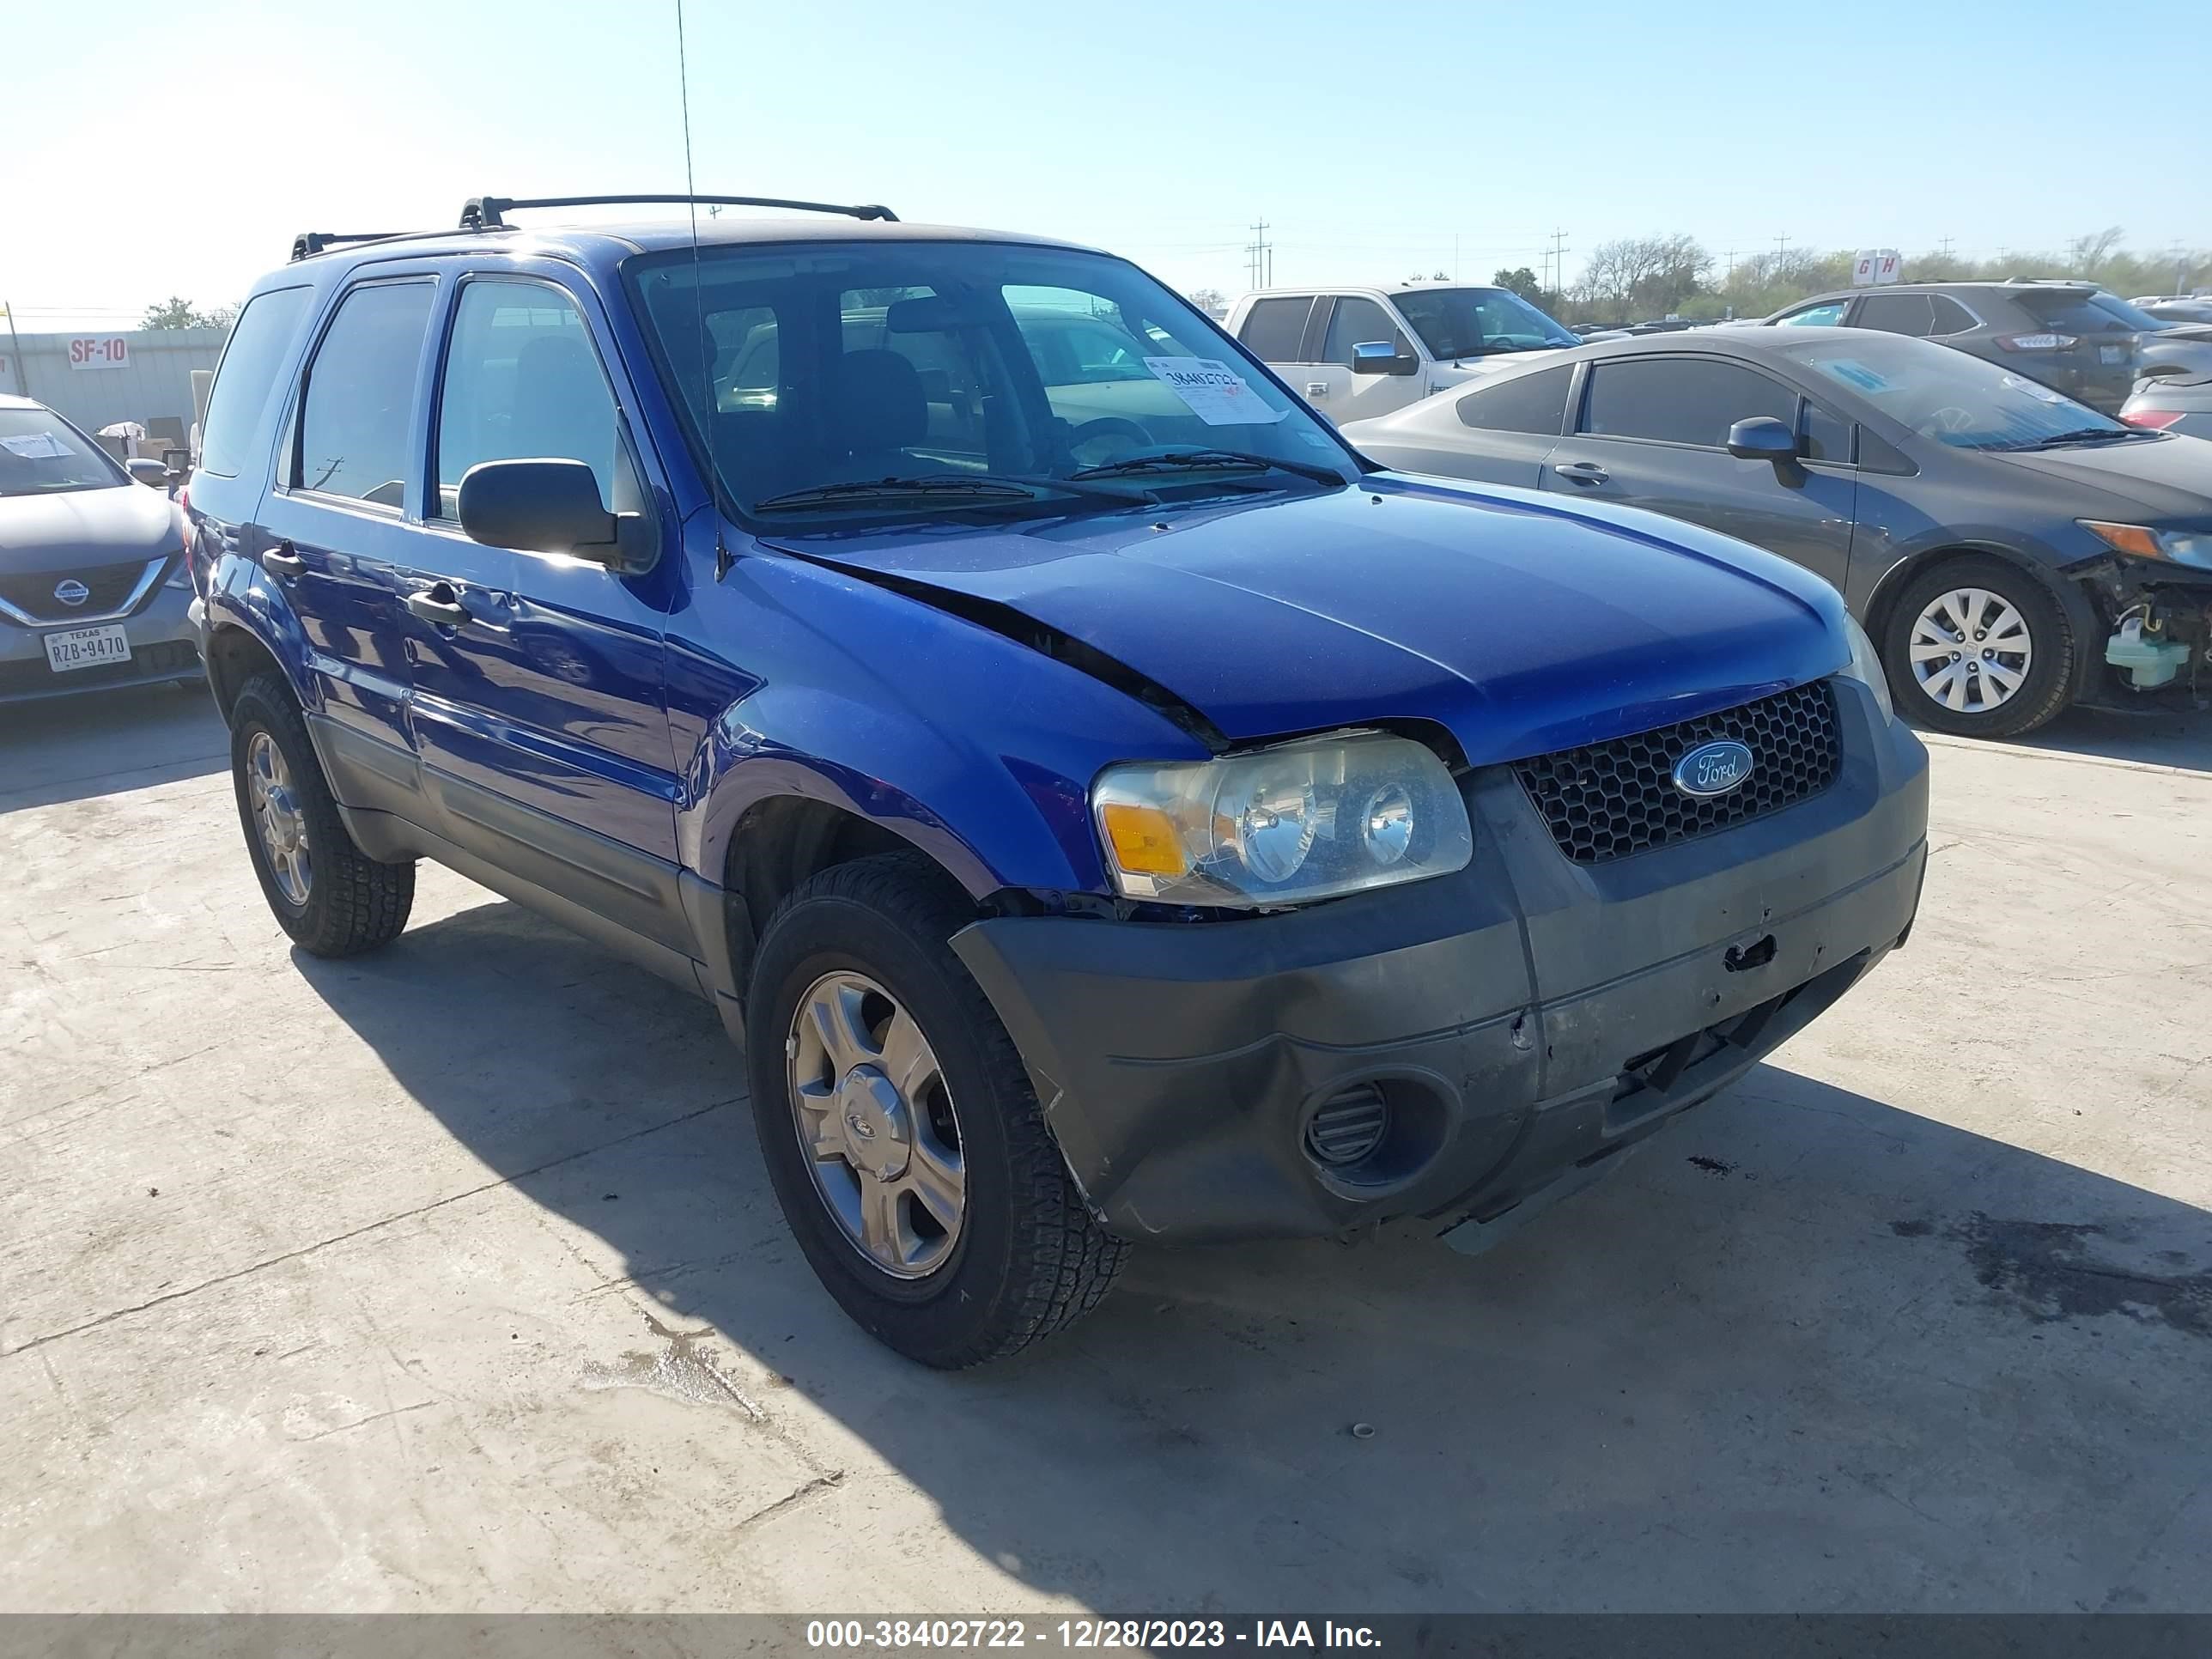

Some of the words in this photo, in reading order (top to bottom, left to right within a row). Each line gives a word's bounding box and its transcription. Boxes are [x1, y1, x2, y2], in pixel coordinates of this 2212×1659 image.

[1859, 259, 1869, 274] G
[1882, 258, 1895, 273] H
[70, 338, 125, 362] SF-10
[69, 629, 100, 640] TEXAS
[1697, 751, 1739, 786] Ford
